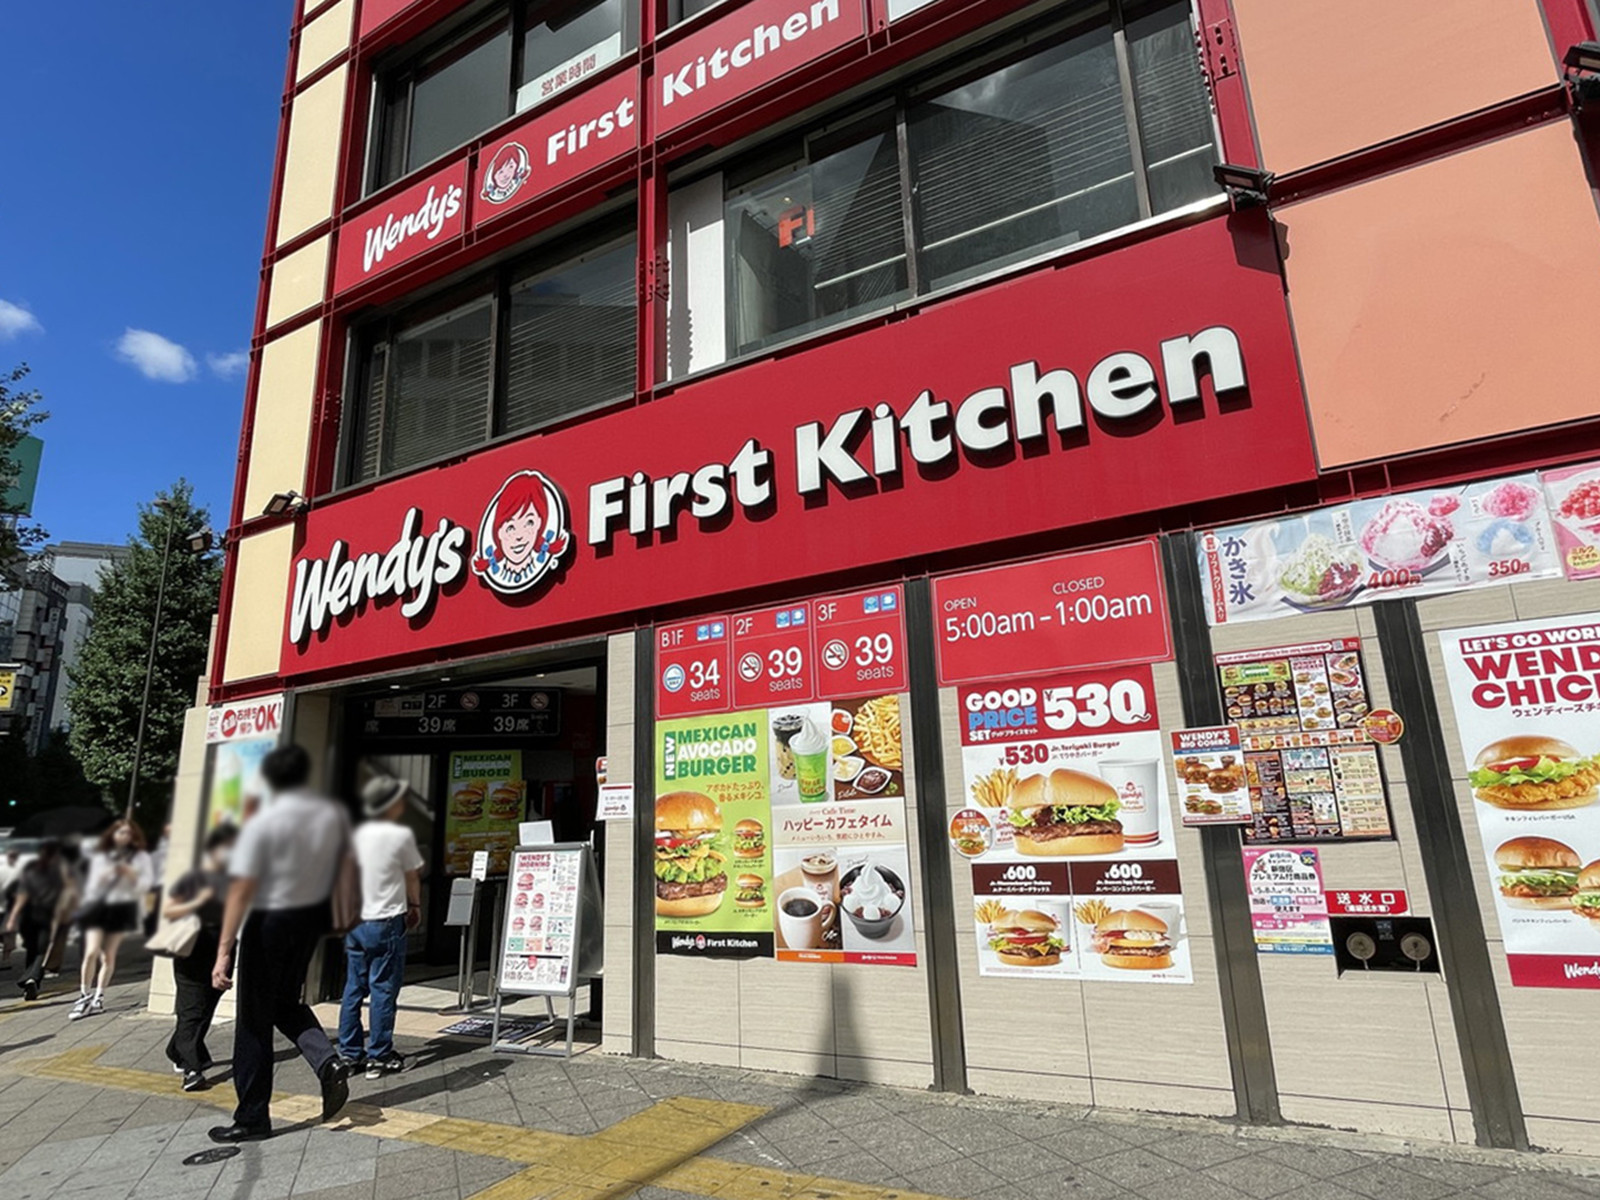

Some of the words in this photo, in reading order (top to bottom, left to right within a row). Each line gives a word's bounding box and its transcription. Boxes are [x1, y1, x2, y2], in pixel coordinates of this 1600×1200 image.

[540, 54, 596, 97] 営業時間
[362, 184, 462, 272] Wendy's
[547, 97, 634, 165] First
[663, 0, 840, 107] Kitchen
[290, 507, 465, 644] Wendy's
[588, 439, 771, 546] First
[796, 325, 1248, 493] Kitchen
[1223, 536, 1255, 605] かき氷
[1488, 559, 1530, 576] 350円
[1053, 576, 1104, 595] CLOSED
[1368, 568, 1421, 588] 400円
[818, 603, 837, 621] 3F
[944, 597, 977, 612] OPEN
[736, 618, 753, 635] 2F
[946, 611, 1035, 642] 5:00am
[1055, 593, 1152, 626] 1:00am
[661, 629, 684, 648] B1F
[1462, 637, 1509, 652] LET'S
[1512, 633, 1542, 647] GO
[855, 633, 894, 666] 39
[768, 646, 803, 678] 39
[689, 659, 720, 689] 34
[857, 664, 894, 681] seats
[769, 677, 803, 692] seats
[428, 694, 446, 709] 2F
[502, 693, 518, 708] 3F
[690, 688, 720, 702] seats
[966, 687, 1037, 712] GOOD
[968, 706, 1038, 730] PRICE
[677, 722, 757, 744] MEXICAN
[969, 729, 991, 742] SET
[1179, 730, 1230, 741] WENDY'S
[676, 738, 757, 760] AVOCADO
[1197, 738, 1230, 747] COMBO
[464, 754, 511, 762] MEXICAN
[665, 735, 675, 777] NEW
[999, 743, 1049, 766] ¥530
[462, 768, 510, 777] BURGER
[677, 755, 757, 778] BURGER
[783, 814, 892, 832] ハッピーカフェタイム
[1003, 865, 1036, 880] ¥600
[1104, 863, 1142, 879] ¥600
[1336, 892, 1396, 905] 送水口
[707, 939, 726, 948] First
[727, 938, 758, 948] Kitchen
